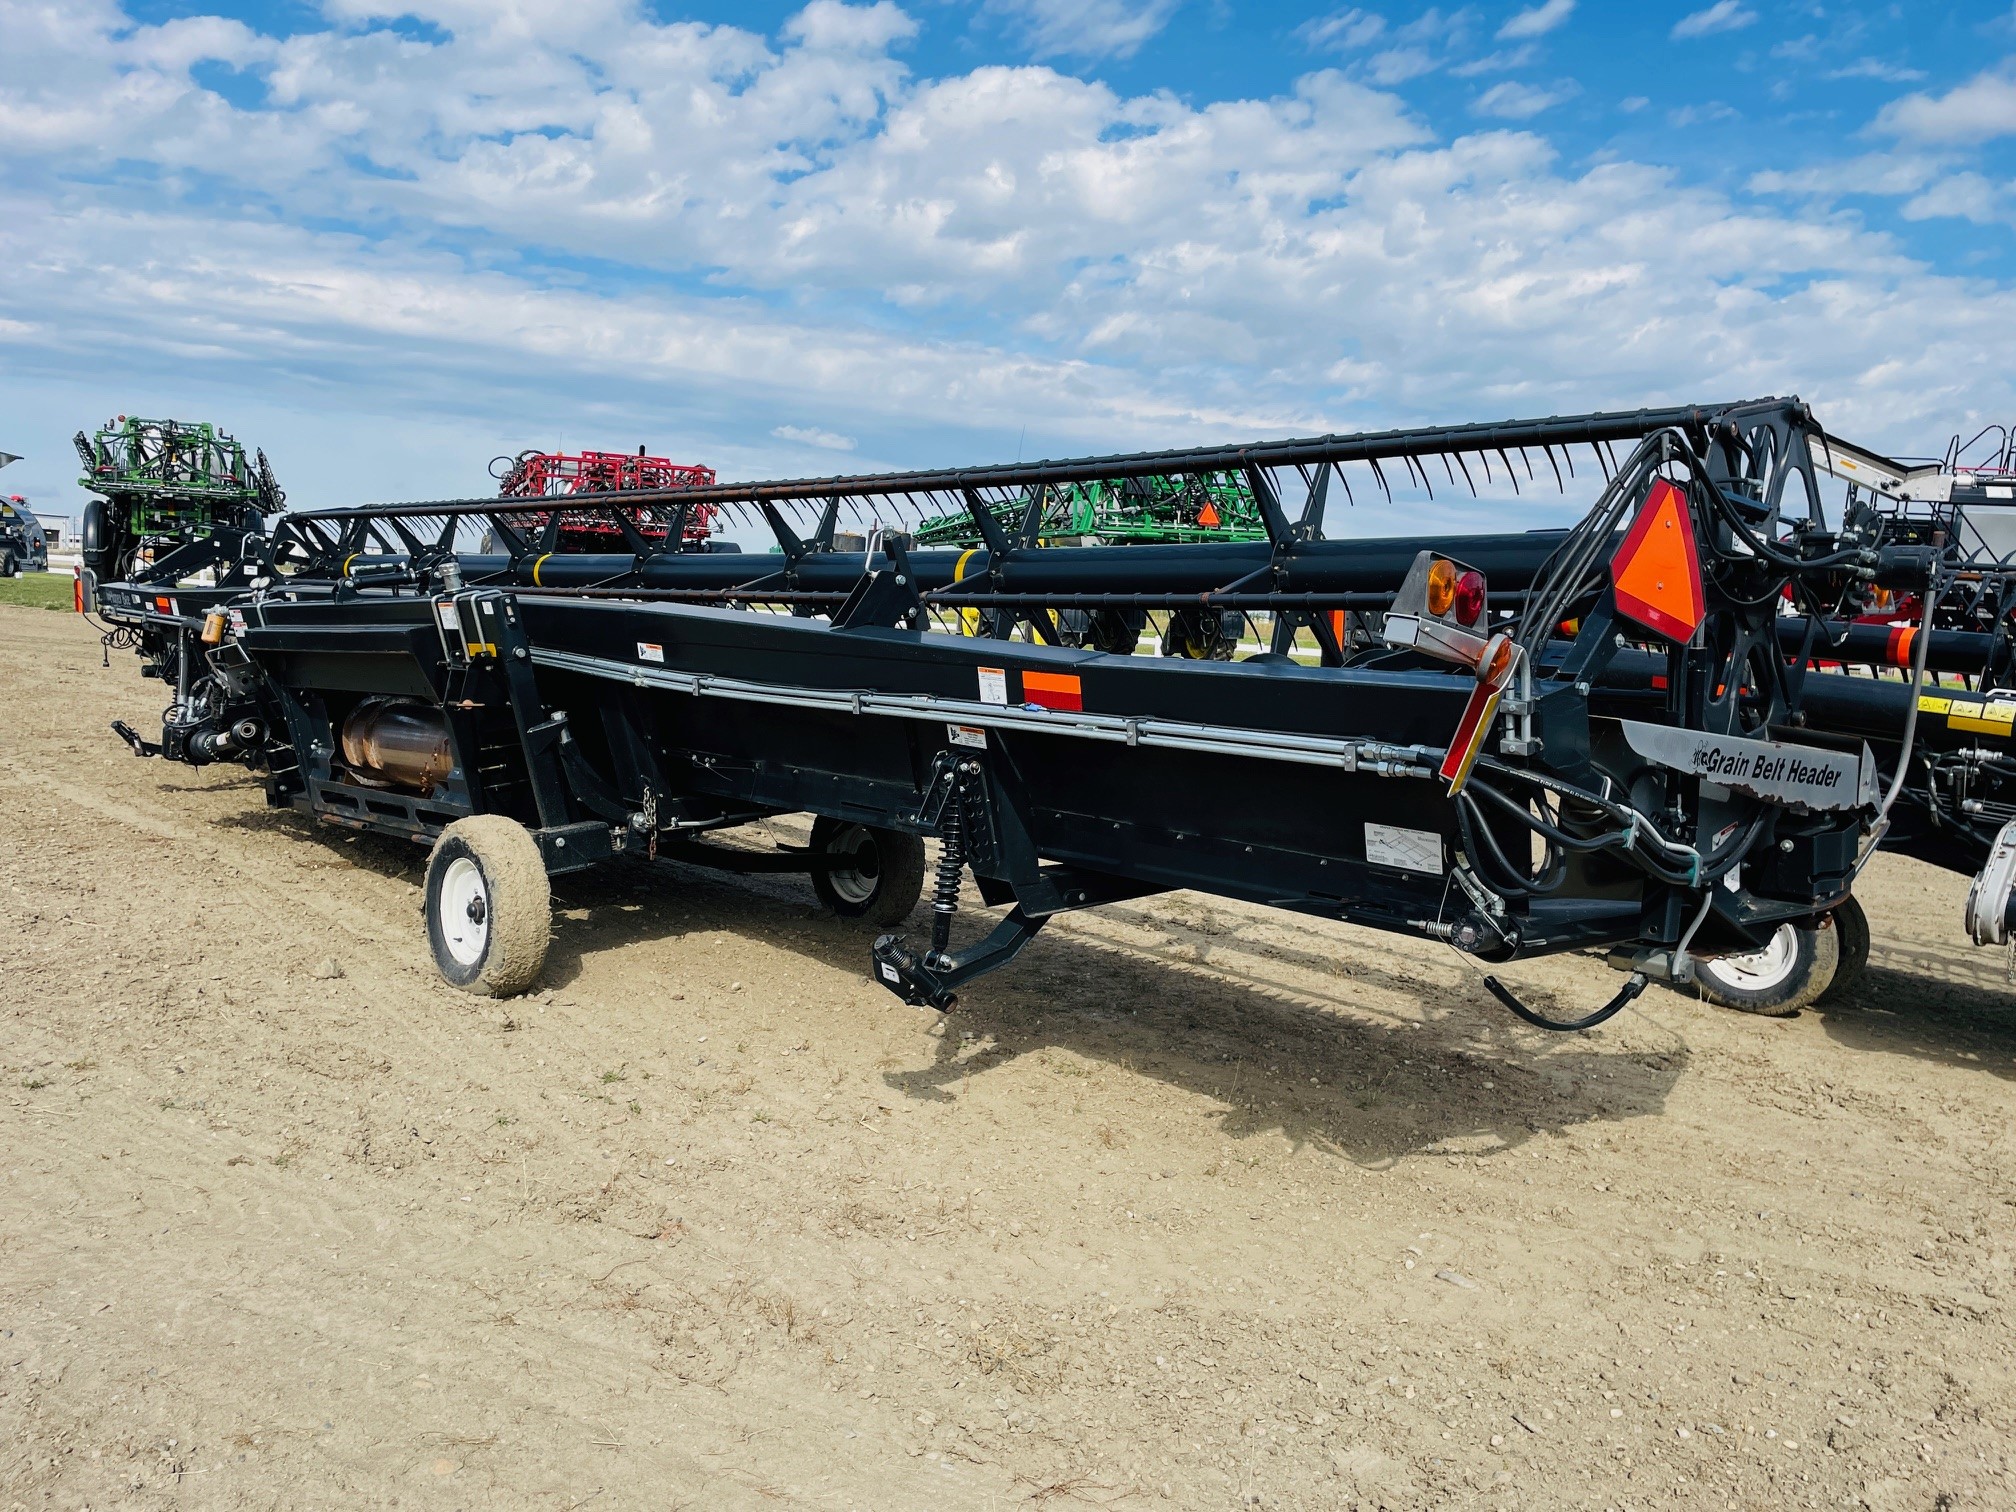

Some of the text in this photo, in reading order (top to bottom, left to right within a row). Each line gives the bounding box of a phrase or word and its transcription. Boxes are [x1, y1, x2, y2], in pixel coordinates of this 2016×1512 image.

[1706, 748, 1842, 788] Grain Belt Header
